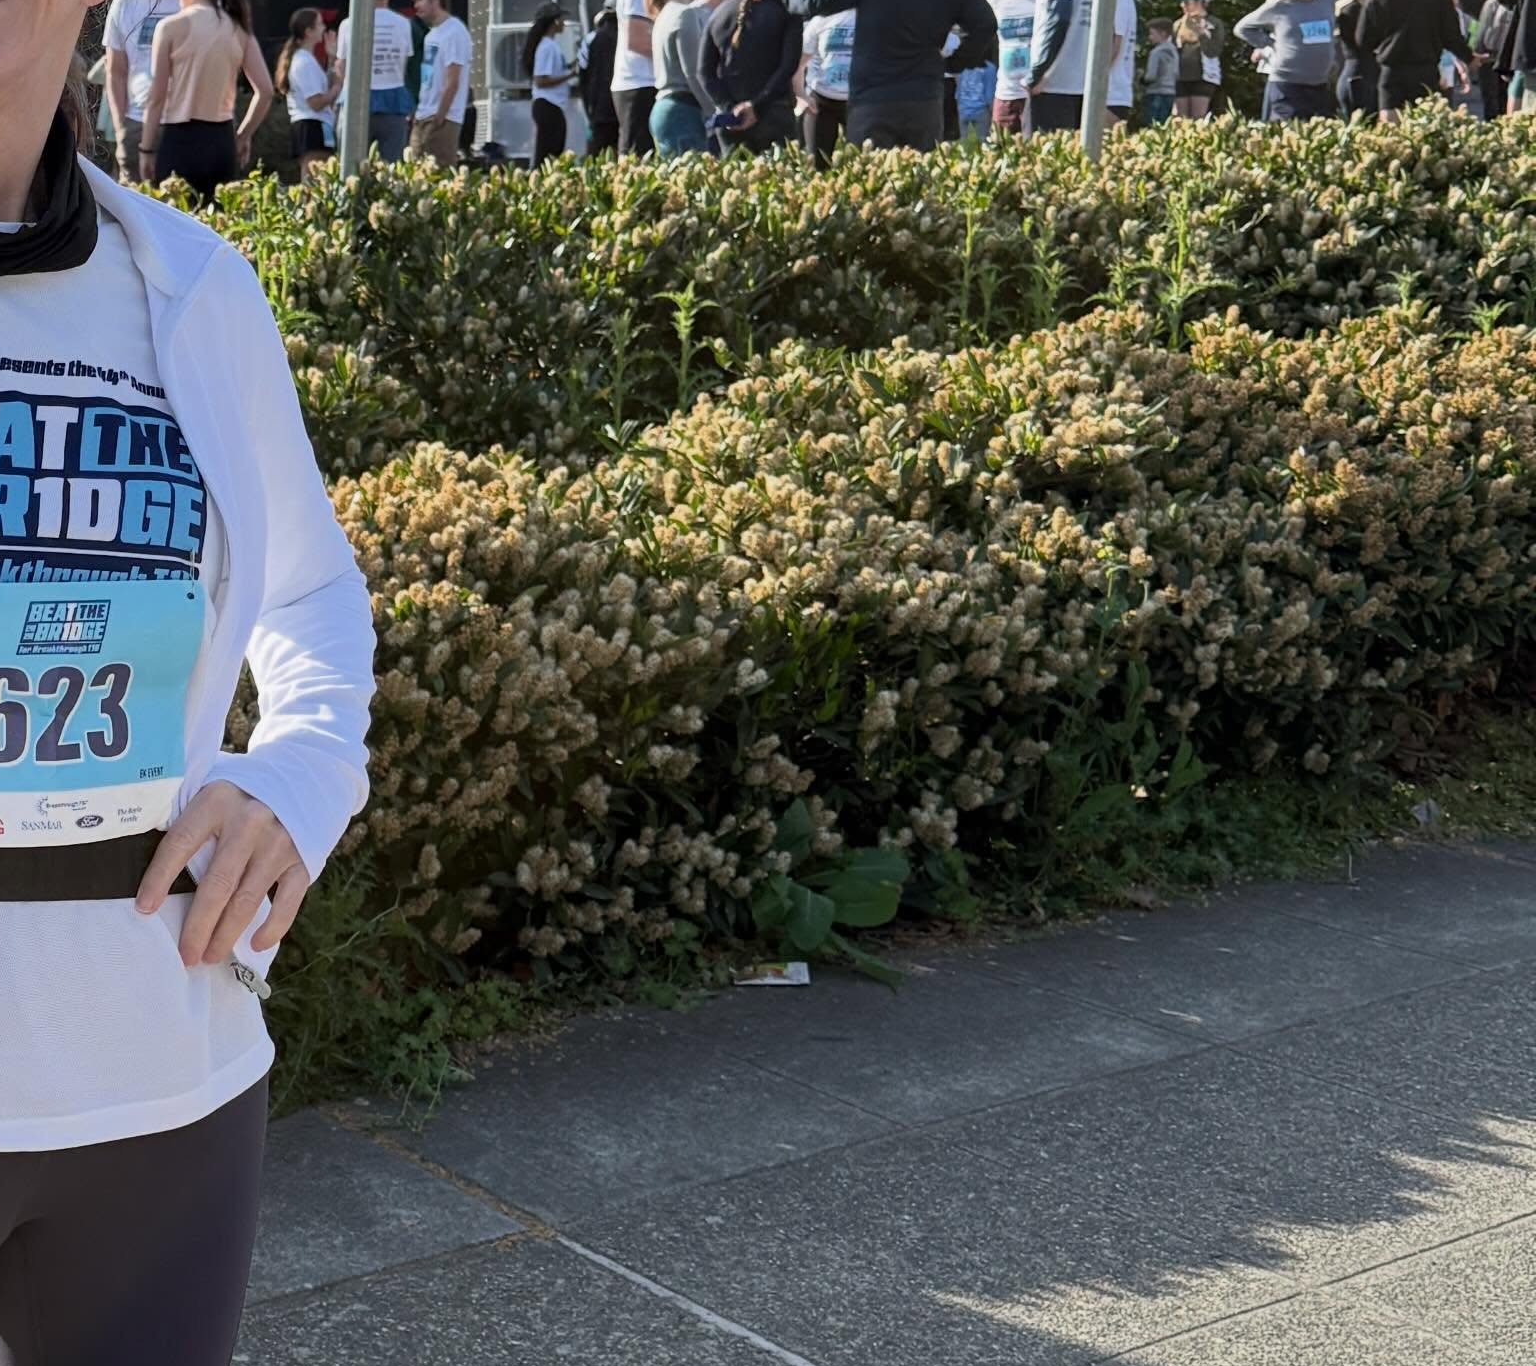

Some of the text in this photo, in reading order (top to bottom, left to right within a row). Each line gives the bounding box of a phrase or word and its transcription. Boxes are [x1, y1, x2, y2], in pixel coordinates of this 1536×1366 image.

[68, 360, 97, 378] the
[83, 412, 195, 476] THE
[28, 602, 106, 622] BEAT THE
